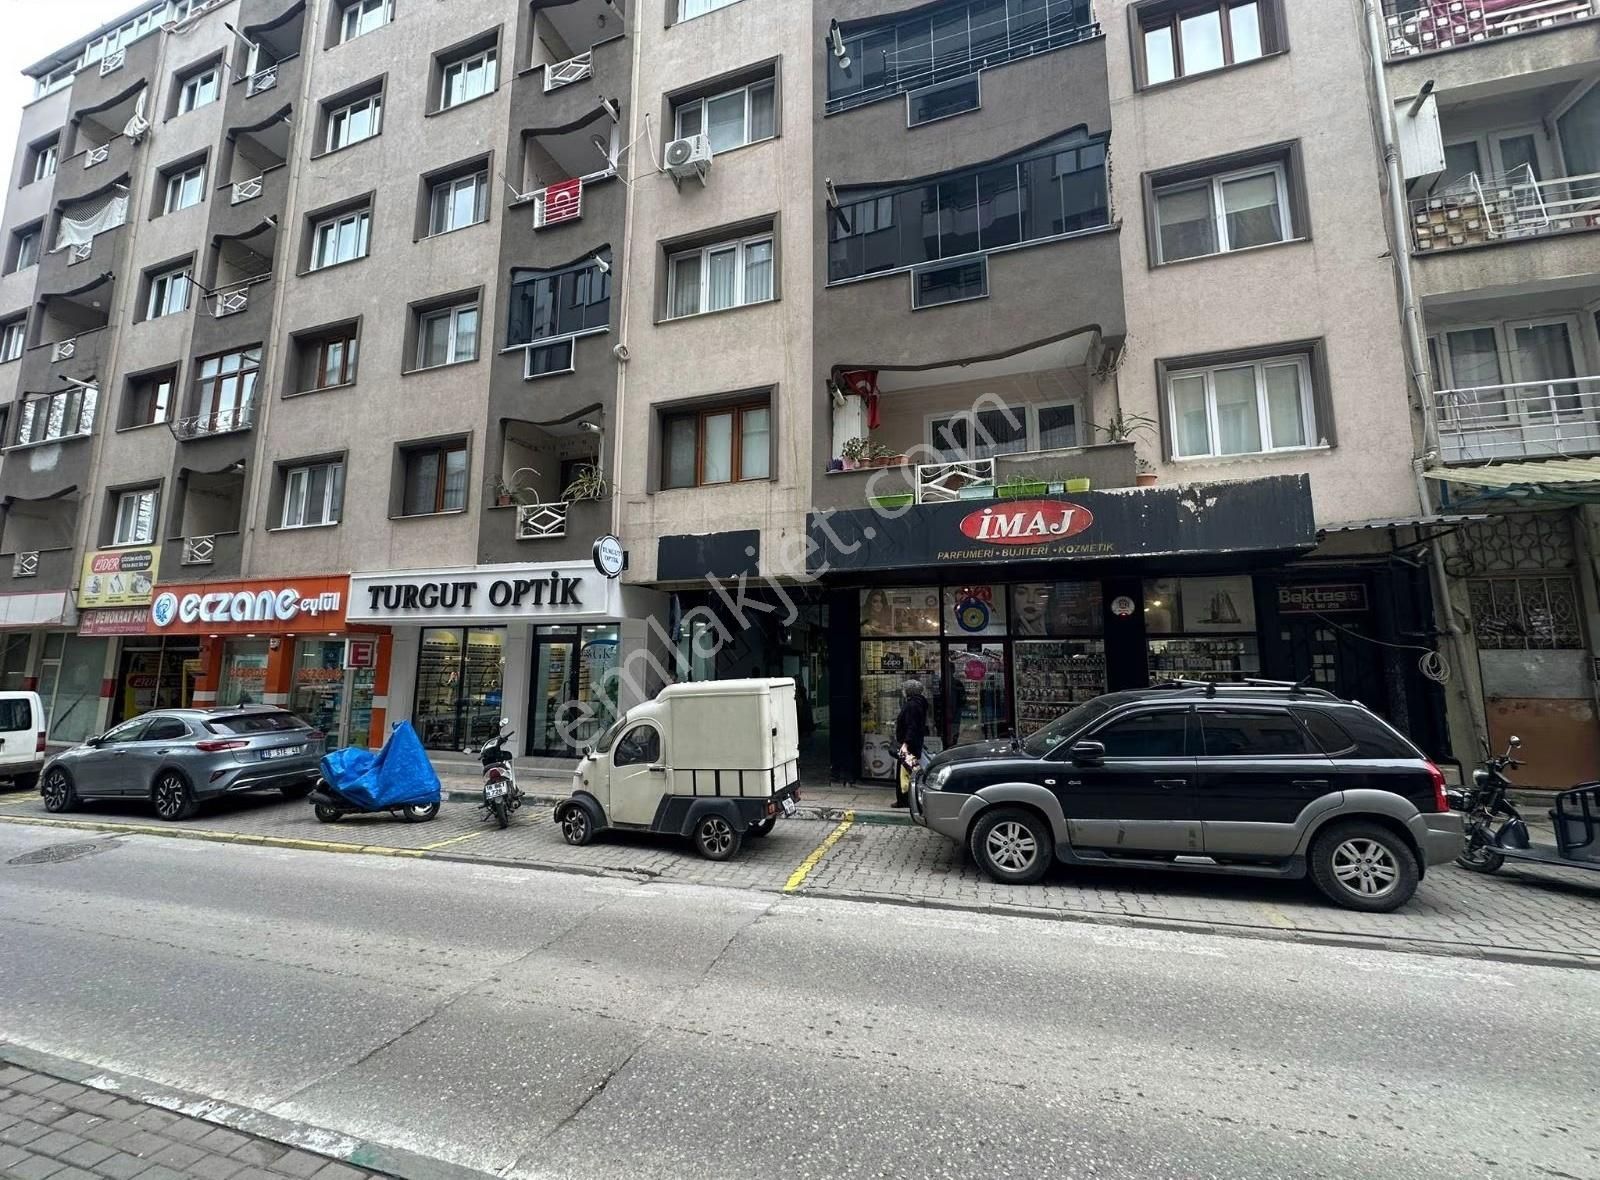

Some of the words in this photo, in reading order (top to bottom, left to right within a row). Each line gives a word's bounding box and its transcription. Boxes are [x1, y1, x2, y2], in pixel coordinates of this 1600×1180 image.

[975, 507, 1076, 540] İMAJ
[179, 588, 300, 624] eczane
[300, 591, 342, 616] eylül
[367, 581, 478, 610] TURGUT
[488, 570, 584, 607] OPTİK
[351, 643, 372, 665] E
